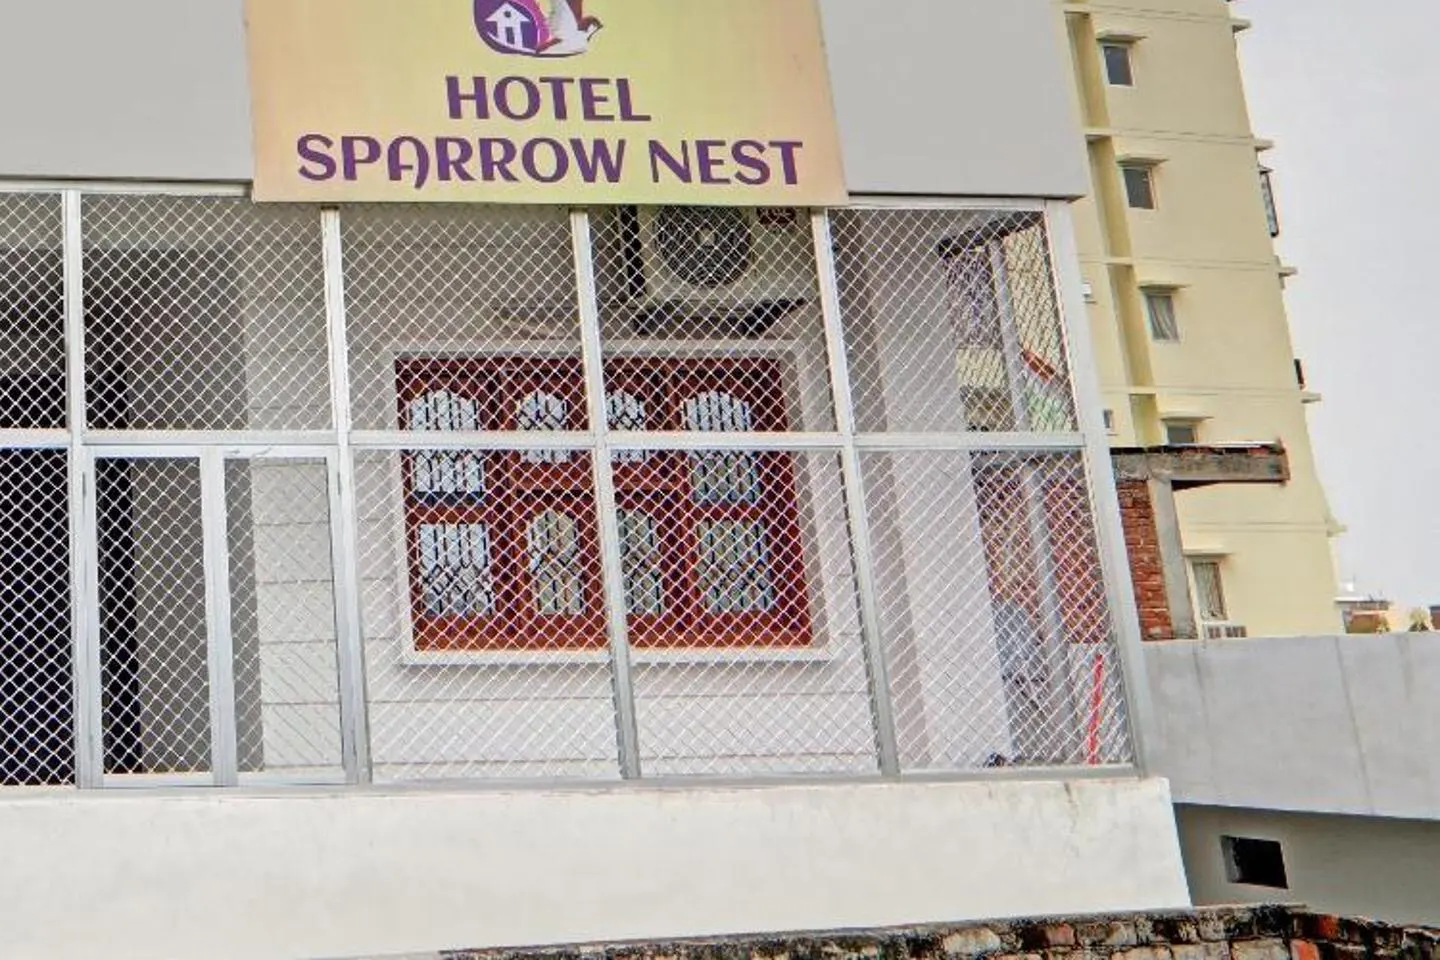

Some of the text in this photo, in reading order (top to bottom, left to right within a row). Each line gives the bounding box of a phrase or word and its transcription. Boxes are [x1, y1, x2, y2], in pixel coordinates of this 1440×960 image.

[445, 75, 652, 122] HOTEL
[297, 133, 804, 190] SPARROW NEST
